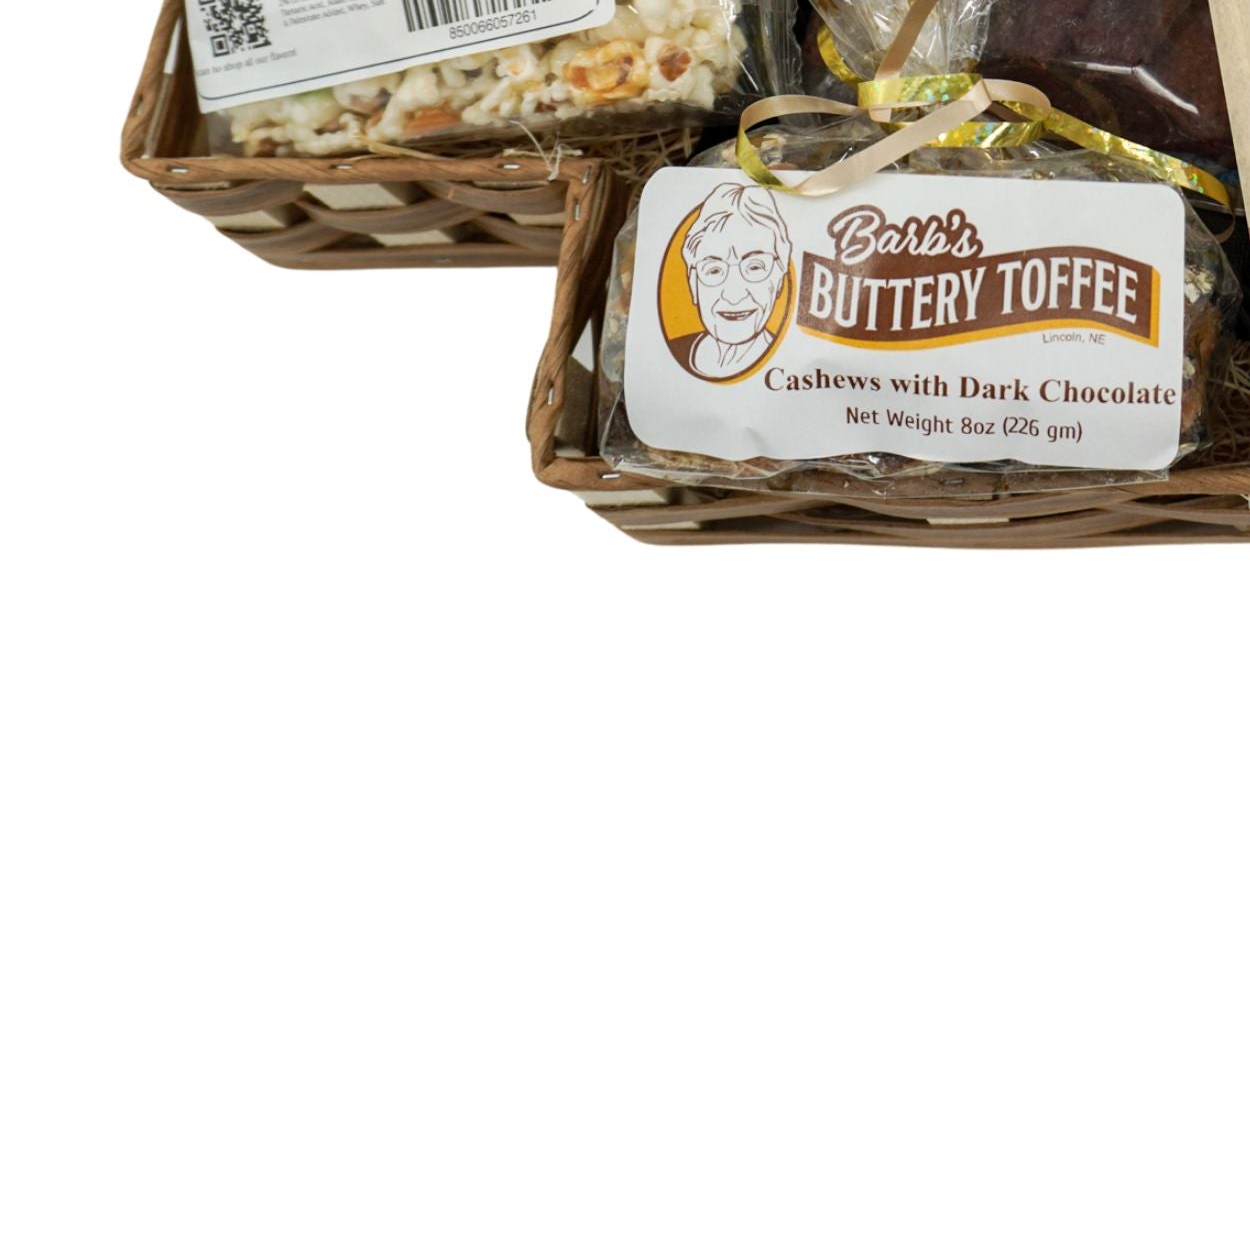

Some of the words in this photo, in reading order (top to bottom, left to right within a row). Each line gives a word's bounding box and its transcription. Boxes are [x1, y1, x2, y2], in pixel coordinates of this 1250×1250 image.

[449, 10, 537, 39] 850066057261
[831, 208, 980, 266] Barb's
[808, 261, 987, 331] BUTTERY
[997, 256, 1139, 324] TOFFEE
[1042, 332, 1086, 345] Lincoln,
[1088, 333, 1106, 345] NE
[763, 366, 881, 393] Cashews
[890, 373, 948, 398] with
[960, 375, 1030, 402] Dark
[1039, 378, 1177, 406] Chocolate
[846, 407, 879, 425] Net
[886, 409, 952, 437] Weight
[961, 417, 995, 435] 8oz
[1003, 416, 1040, 438] (226
[1047, 420, 1083, 443] gm)
